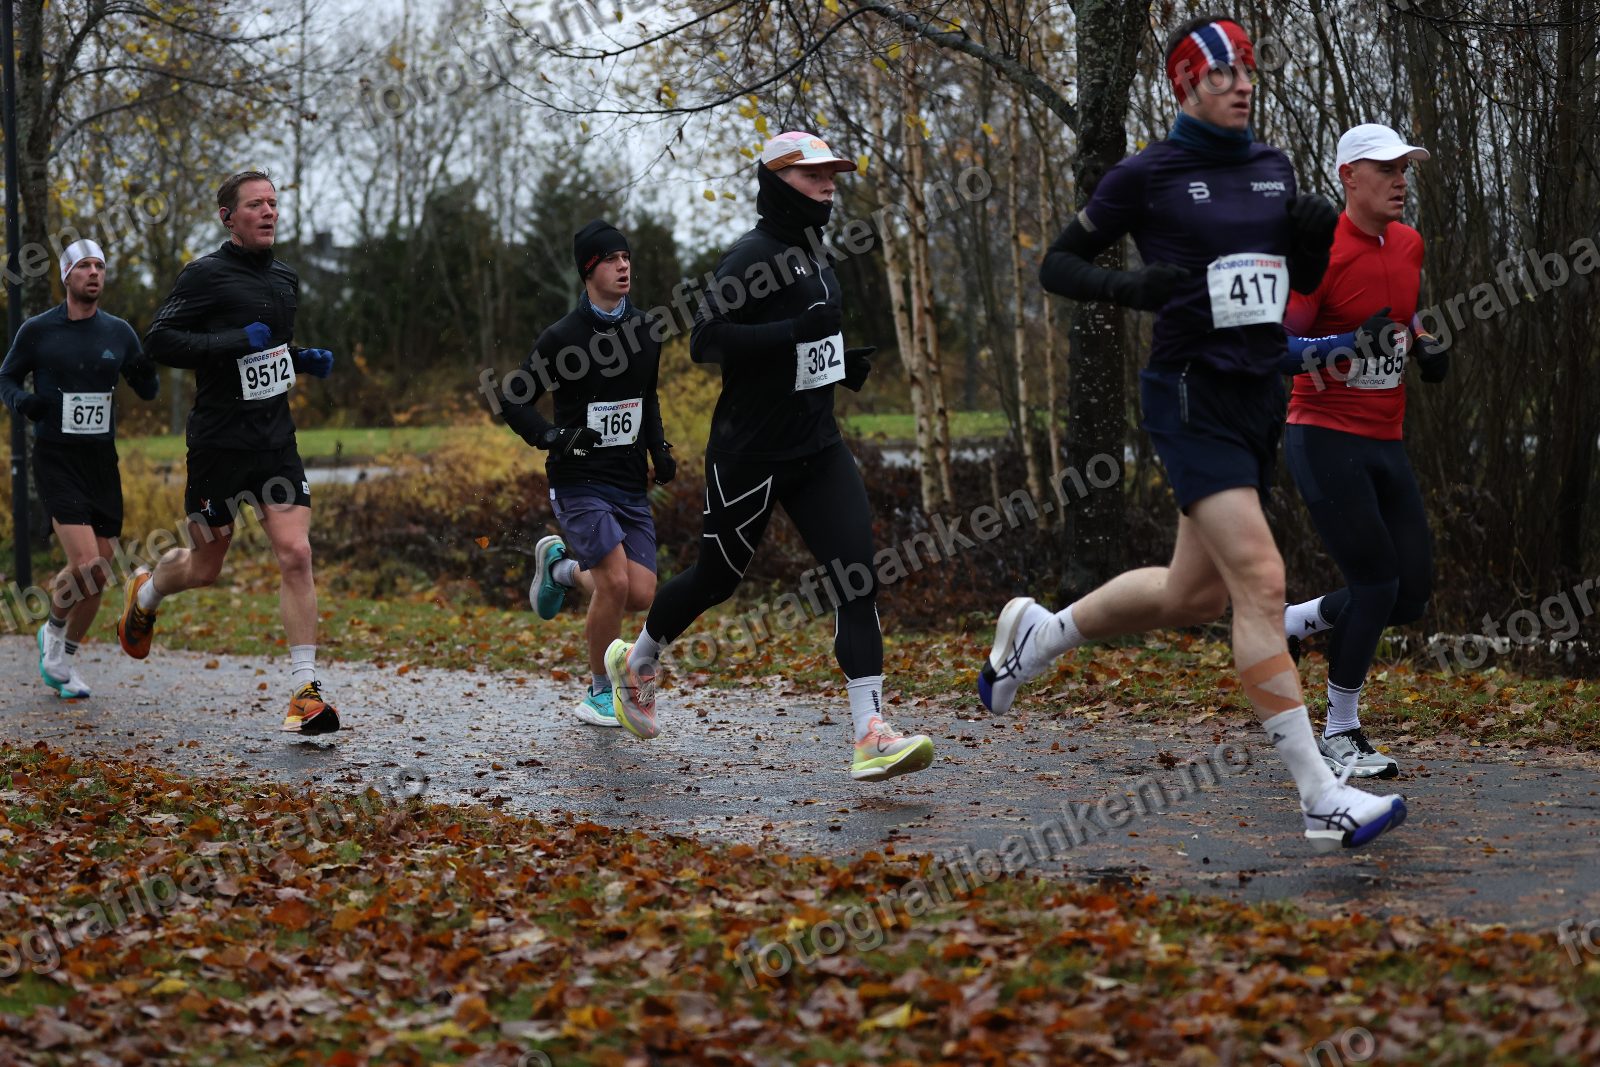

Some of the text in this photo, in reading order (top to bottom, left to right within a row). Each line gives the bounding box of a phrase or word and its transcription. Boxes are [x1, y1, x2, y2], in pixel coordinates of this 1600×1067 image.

[1230, 273, 1278, 306] 417
[246, 357, 291, 390] 9512
[808, 341, 842, 375] 362
[73, 405, 104, 425] 675
[600, 412, 632, 436] 166
